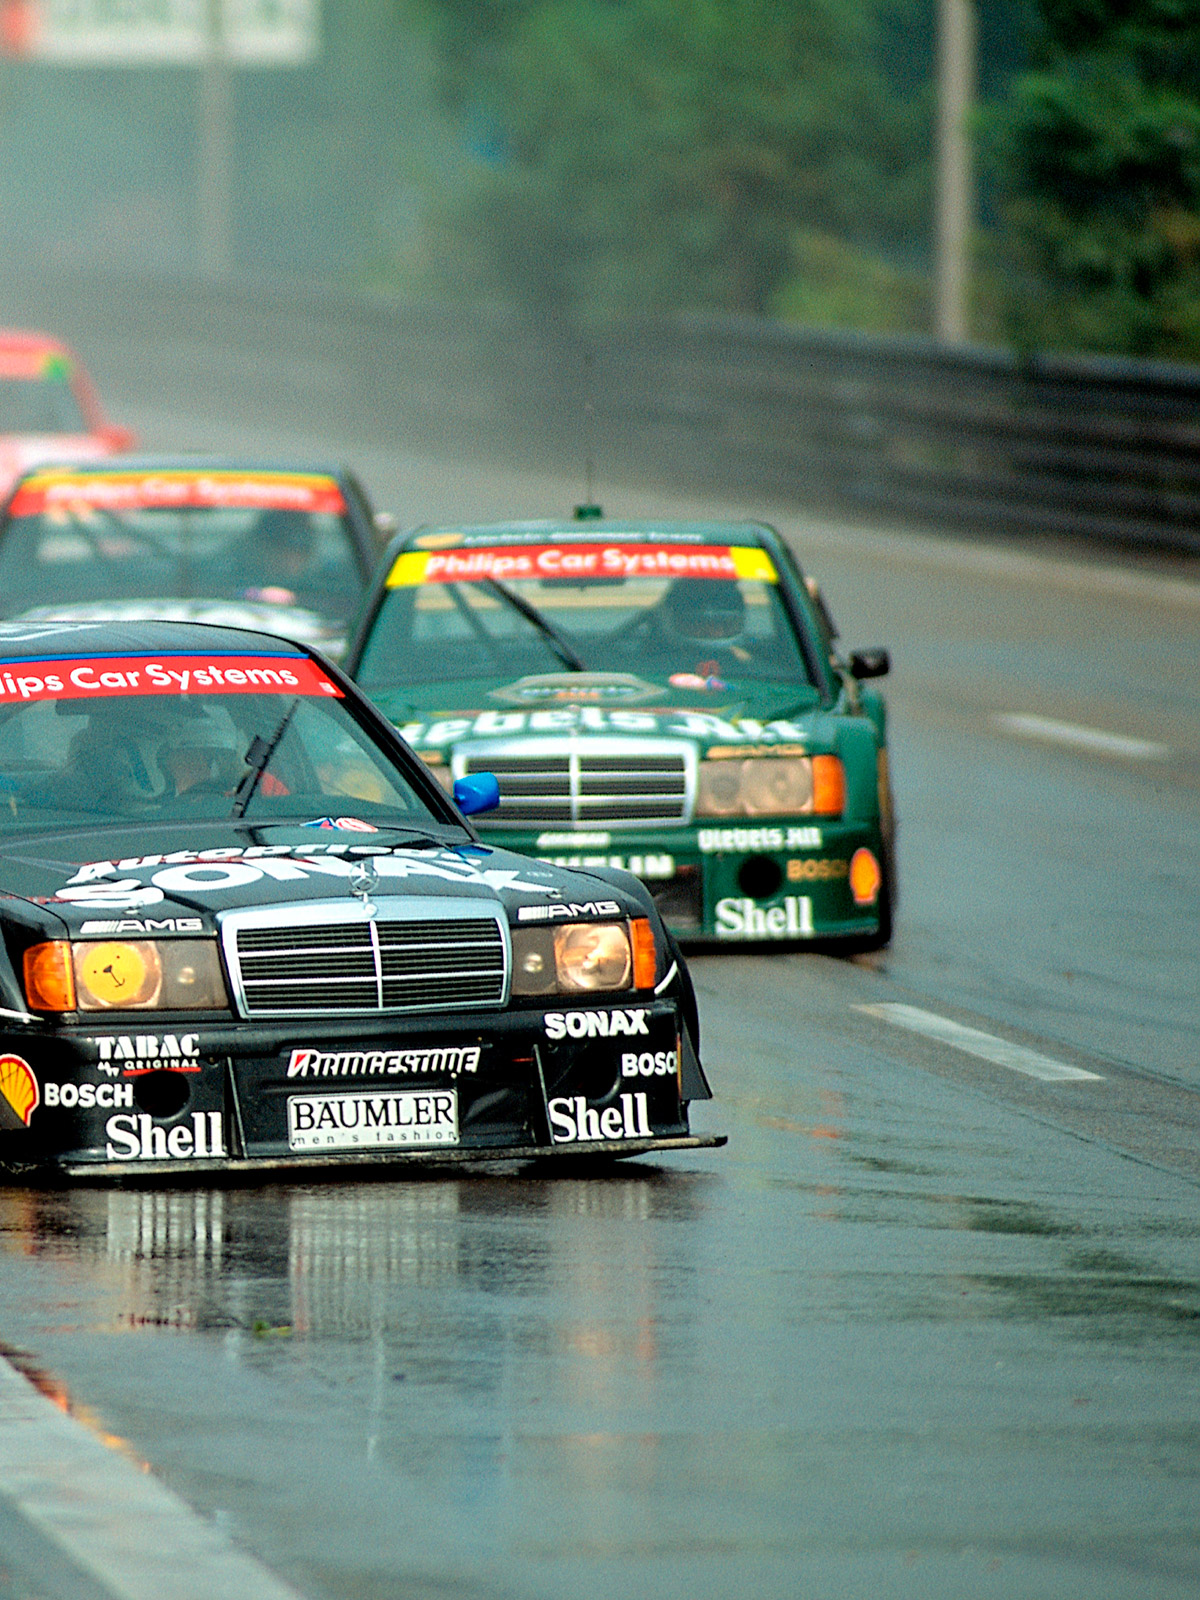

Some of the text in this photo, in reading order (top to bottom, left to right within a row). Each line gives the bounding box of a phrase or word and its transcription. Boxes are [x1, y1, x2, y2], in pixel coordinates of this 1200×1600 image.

[425, 548, 735, 575] Philips Car Systems
[69, 667, 141, 689] Car
[145, 663, 300, 691] Systems
[55, 856, 560, 908] SONAX
[787, 859, 848, 882] BOSC
[548, 900, 621, 918] AMG
[715, 896, 814, 937] Shell
[114, 917, 203, 933] AMG
[544, 1009, 650, 1039] SONAX
[94, 1033, 200, 1059] TABAC
[124, 1059, 199, 1070] ORIGINAL
[287, 1046, 481, 1078] BRIDGESTONE
[621, 1051, 677, 1077] BOSC
[44, 1083, 133, 1107] BOSCH
[293, 1096, 454, 1131] BÄUMLER
[548, 1092, 654, 1143] Shell
[104, 1111, 227, 1160] Shell
[293, 1130, 458, 1145] men's fashion
